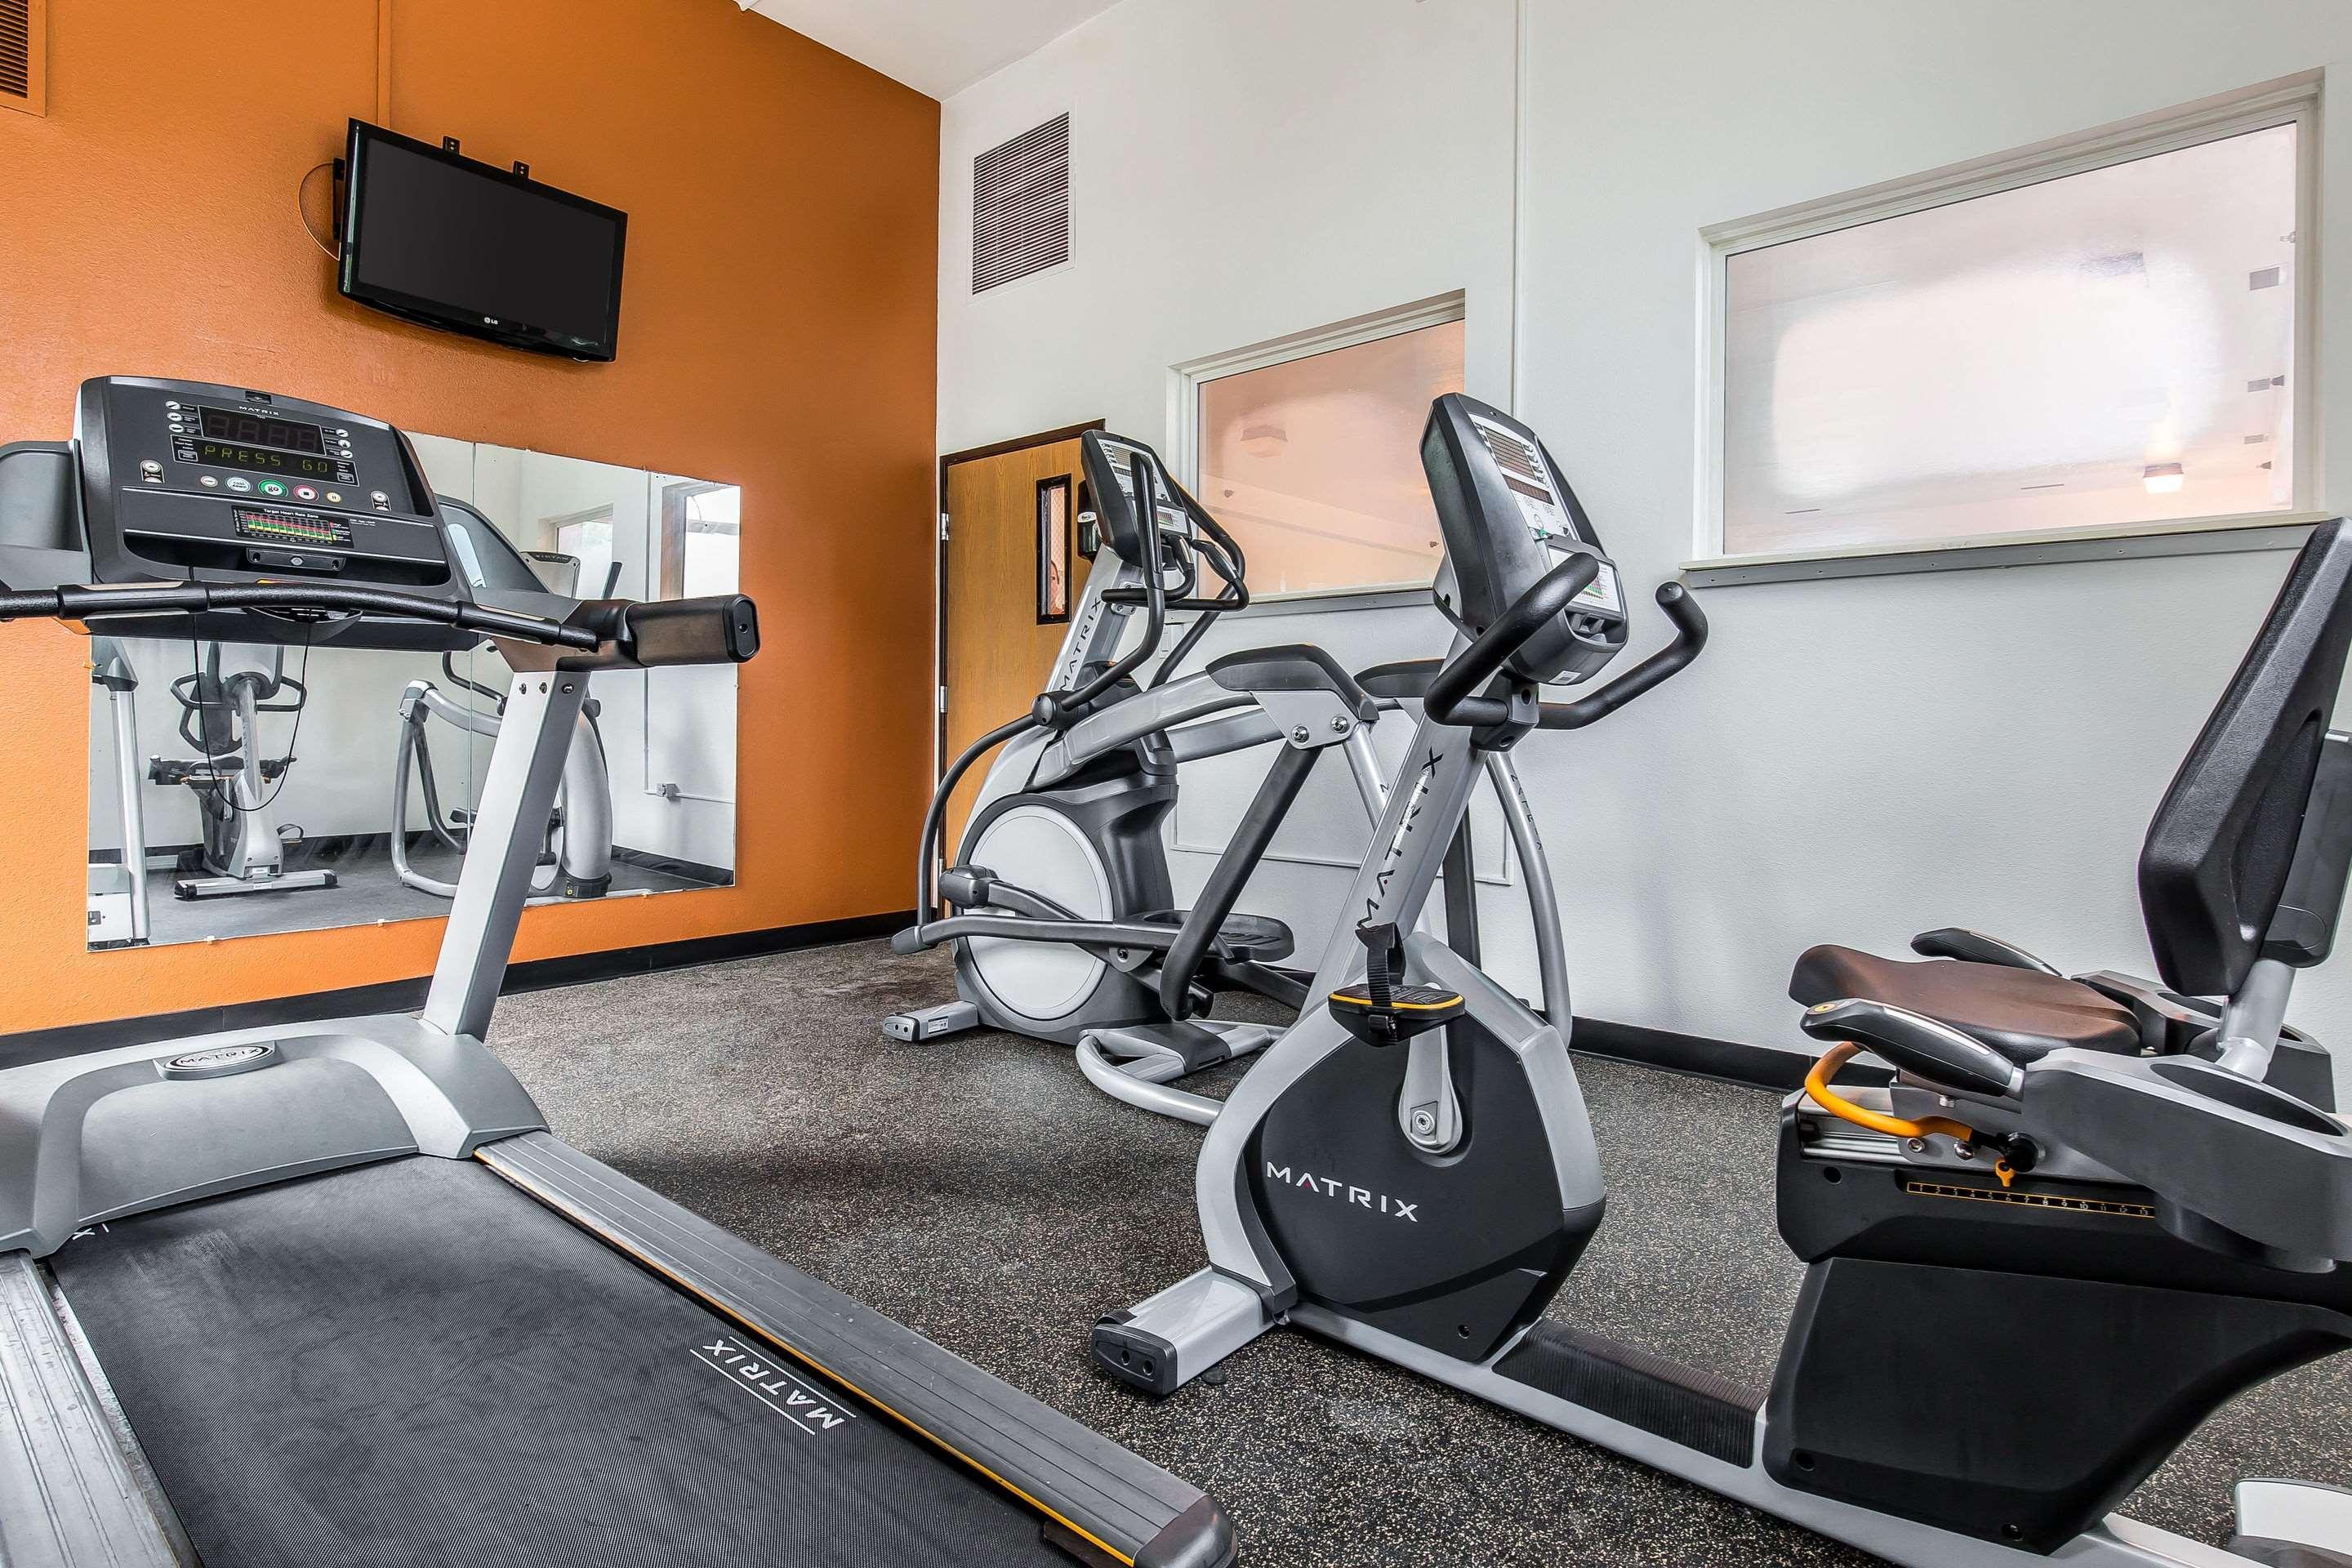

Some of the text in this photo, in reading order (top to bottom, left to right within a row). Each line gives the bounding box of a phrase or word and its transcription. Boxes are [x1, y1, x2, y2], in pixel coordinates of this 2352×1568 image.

[239, 406, 279, 416] MATRIX
[204, 445, 281, 466] PRESS
[302, 459, 327, 473] GO
[1059, 596, 1101, 691] MATRIX
[180, 1048, 259, 1064] MATRIX
[1267, 1161, 1419, 1223] MATRIX
[702, 1339, 845, 1431] MATRIX
